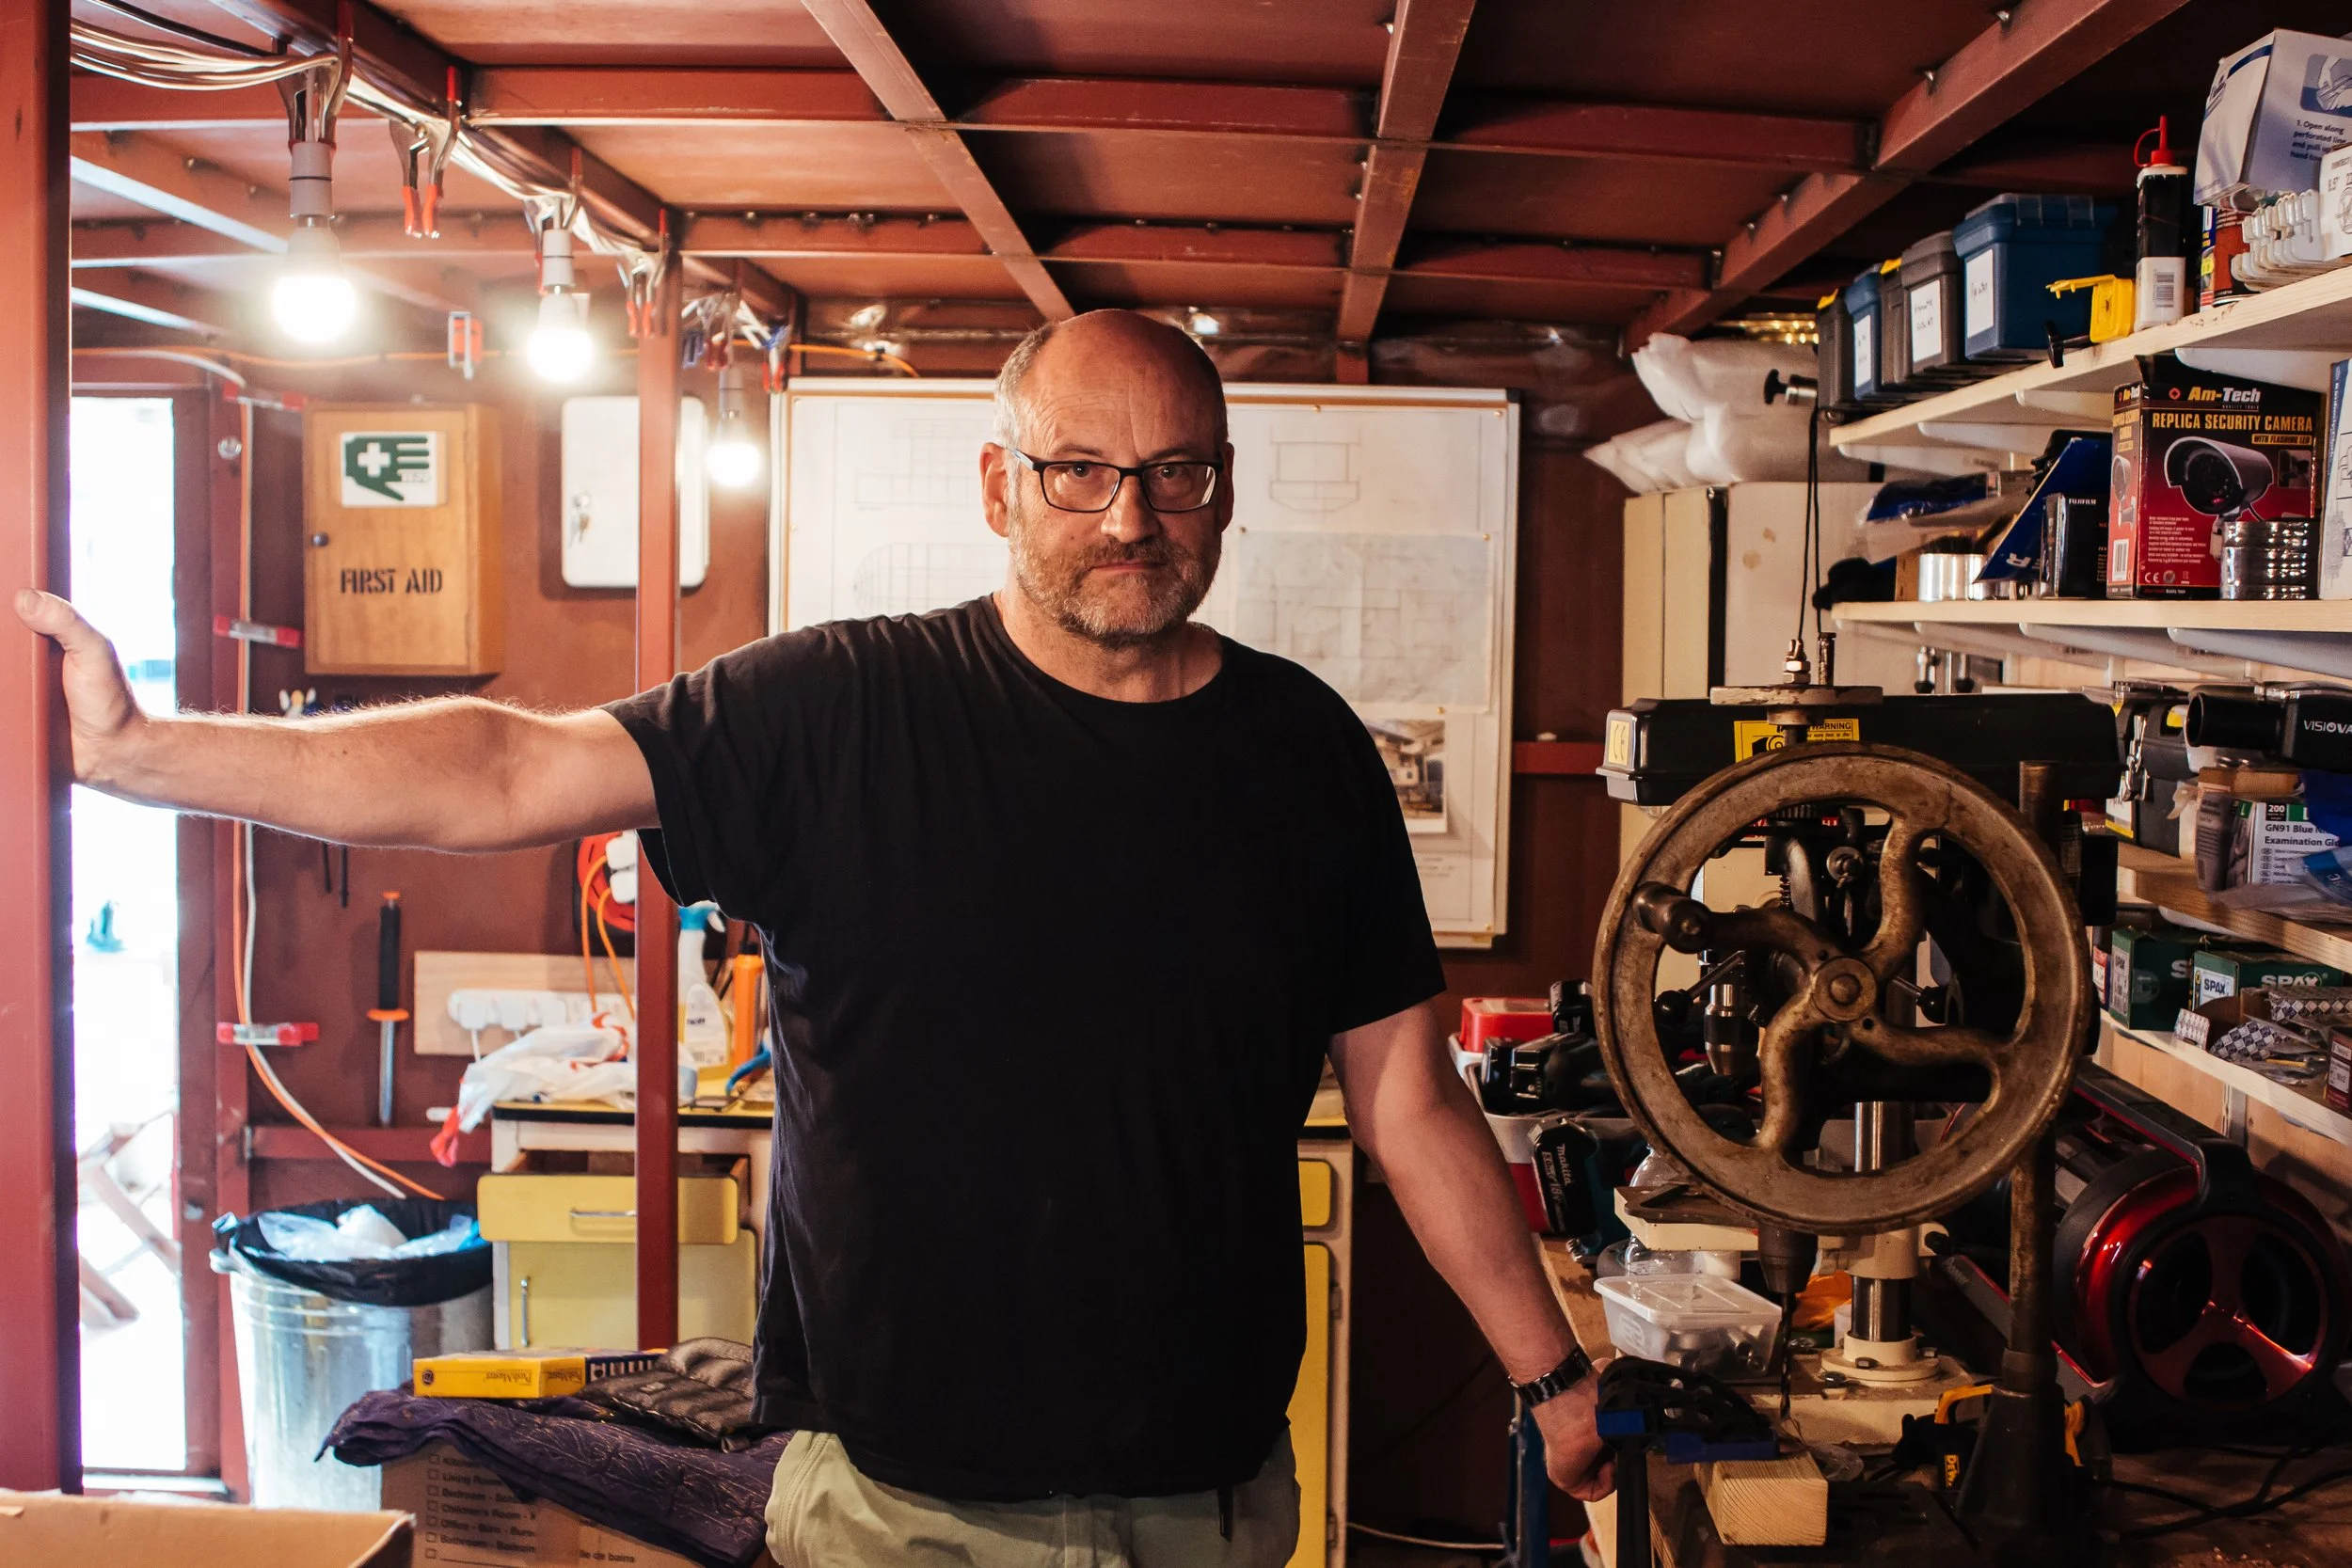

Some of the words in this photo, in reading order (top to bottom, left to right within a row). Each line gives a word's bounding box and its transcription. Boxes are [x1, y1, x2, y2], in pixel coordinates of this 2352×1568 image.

[2303, 120, 2323, 130] Open
[2324, 124, 2344, 135] along
[2187, 386, 2261, 403] Am-Tech
[2152, 412, 2201, 429] REPLICA
[2204, 413, 2261, 430] SECURITY
[2265, 416, 2313, 433] CAMERA
[341, 568, 396, 594] FIRST
[405, 568, 443, 594] AID
[1811, 721, 1851, 730] WARNING
[2268, 804, 2285, 813] 200
[2265, 823, 2290, 832] GN91
[2292, 824, 2313, 833] Blue
[2265, 836, 2323, 847] Examination
[2203, 977, 2226, 995] SPAX
[2261, 974, 2319, 989] SPAX
